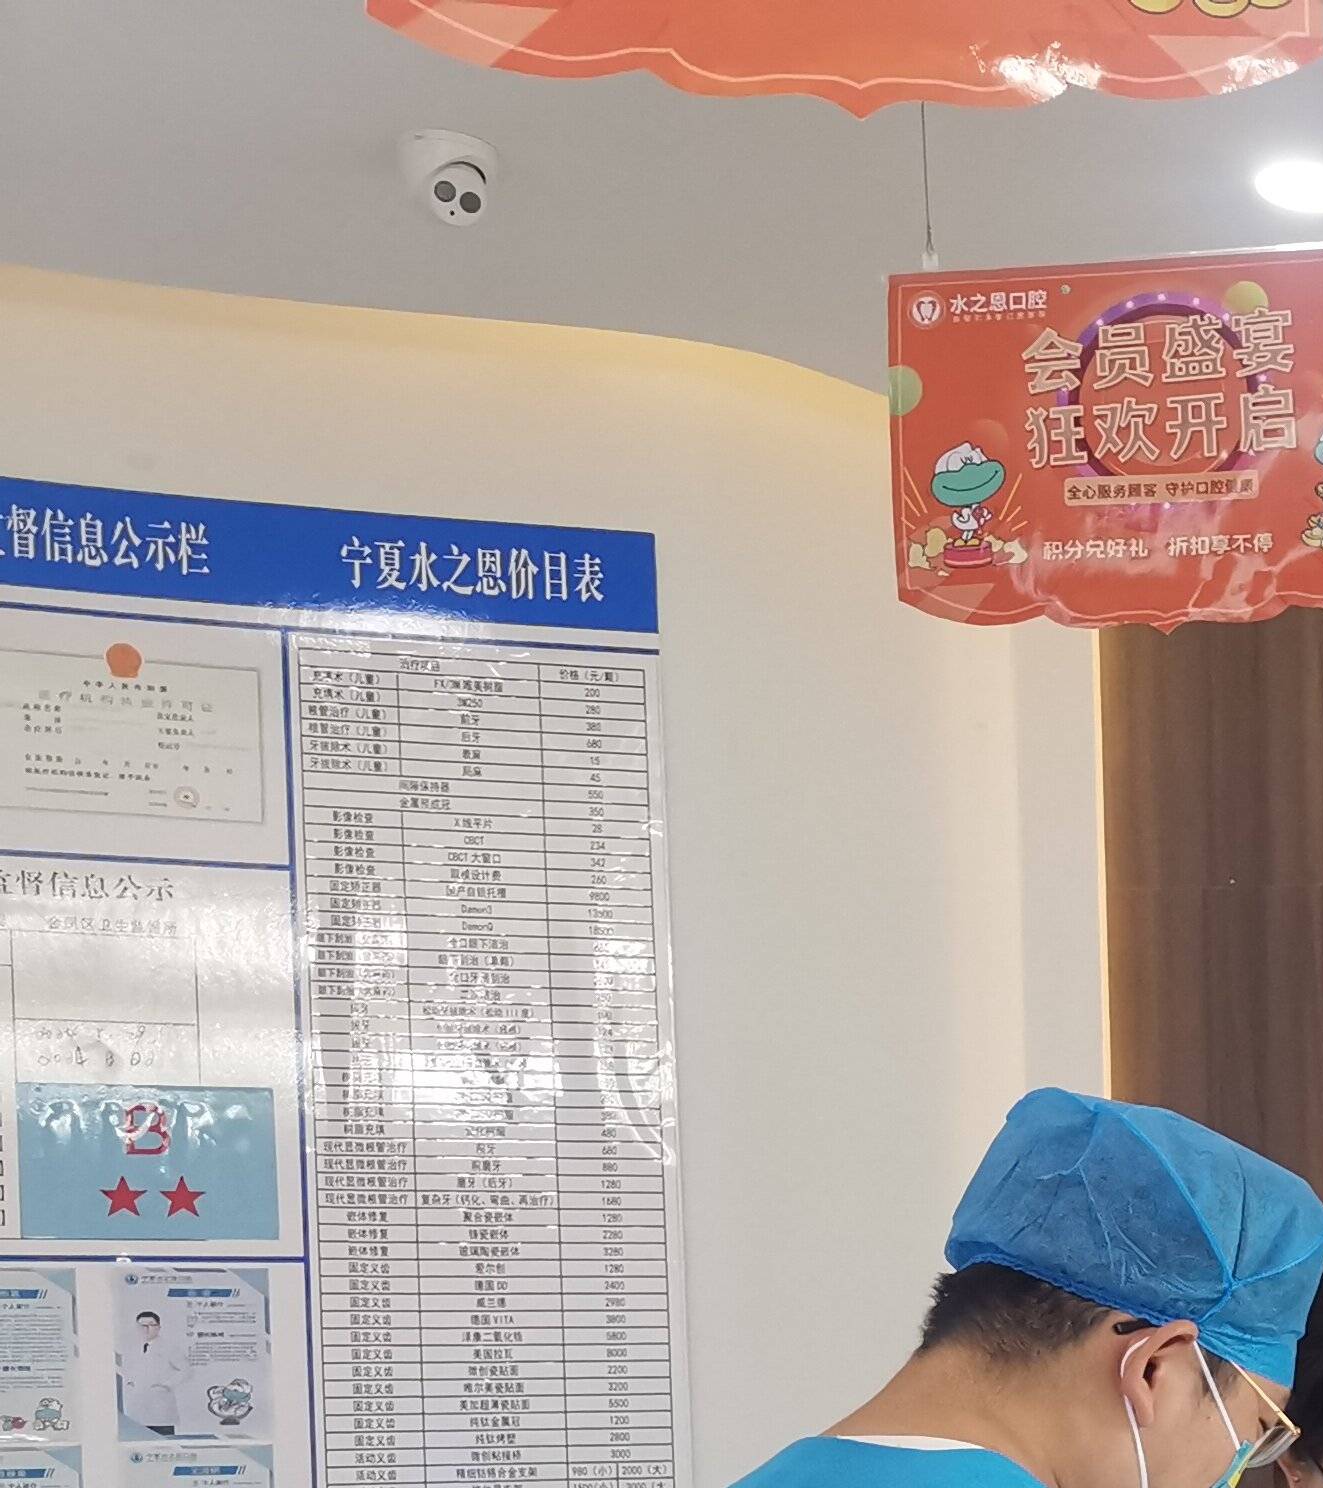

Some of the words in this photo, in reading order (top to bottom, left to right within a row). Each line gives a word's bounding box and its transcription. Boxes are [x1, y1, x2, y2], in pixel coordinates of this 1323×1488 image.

[949, 289, 1048, 314] 水之恩口腔
[1021, 308, 1295, 395] 会员盛宴
[1024, 386, 1297, 469] 狂欢开启
[1066, 480, 1158, 501] 全心服务顾客
[0, 503, 210, 577] 督信息公示栏
[1042, 538, 1149, 561] 积分兑好礼
[1167, 533, 1274, 557] 折扣享不停
[340, 536, 604, 602] 宁夏水之恩价目表
[585, 688, 600, 698] 200
[462, 731, 481, 743] 后牙
[590, 840, 605, 850] 234
[591, 857, 606, 867] 342
[601, 1179, 621, 1189] 1280
[602, 1213, 622, 1223] 1280
[349, 1262, 390, 1274] 固定义齿
[604, 1264, 624, 1273] 1280
[350, 1279, 390, 1291] 固定义齿
[350, 1296, 391, 1308] 固定义齿
[351, 1314, 391, 1325] 固定义齿
[494, 1315, 514, 1324] VITA
[351, 1331, 392, 1343] 固定义齿
[352, 1348, 392, 1360] 固定义齿
[353, 1366, 393, 1377] 固定义齿
[608, 1365, 628, 1375] 2200
[353, 1383, 394, 1395] 固定义齿
[354, 1400, 394, 1412] 固定义齿
[354, 1418, 395, 1429] 固定义齿
[609, 1415, 629, 1425] 1200
[355, 1435, 395, 1446] 固定义齿
[609, 1432, 630, 1442] 2800
[355, 1453, 396, 1464] 活动义齿
[611, 1448, 631, 1459] 3000
[356, 1470, 397, 1481] 活动义齿
